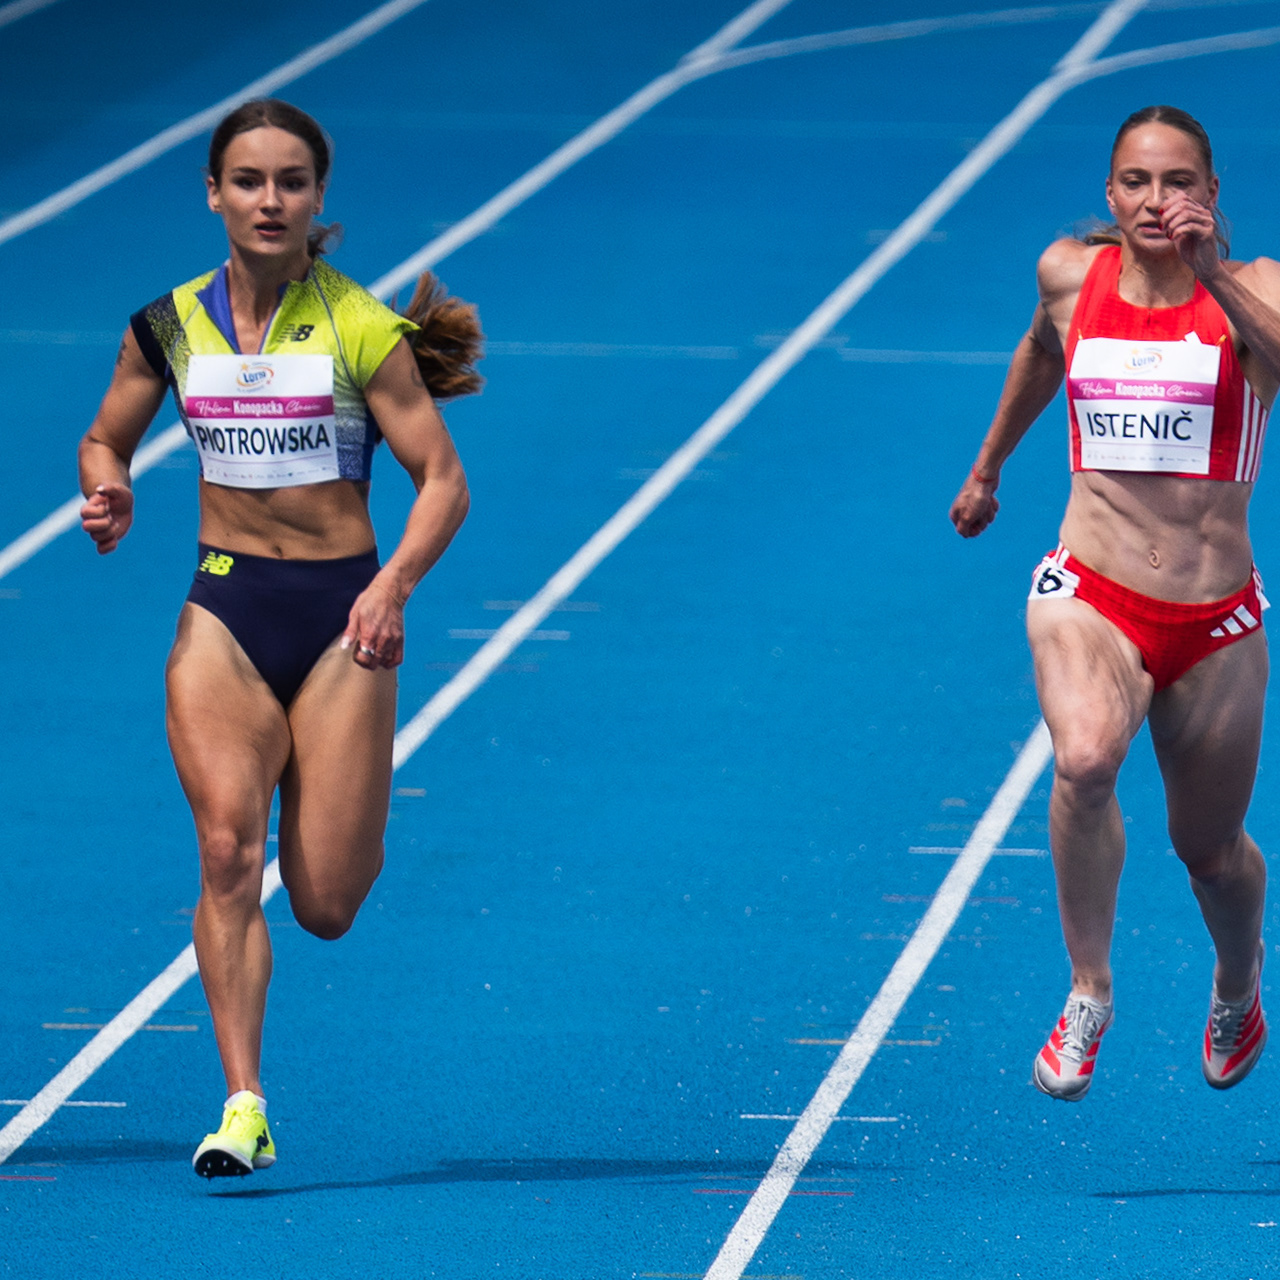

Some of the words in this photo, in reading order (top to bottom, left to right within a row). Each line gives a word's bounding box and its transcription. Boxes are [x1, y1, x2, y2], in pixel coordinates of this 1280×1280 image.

[1115, 381, 1166, 399] Konopacka
[233, 400, 285, 417] Konopacka
[1086, 409, 1193, 441] ISTENIČ
[195, 423, 331, 456] PIOTROWSKA
